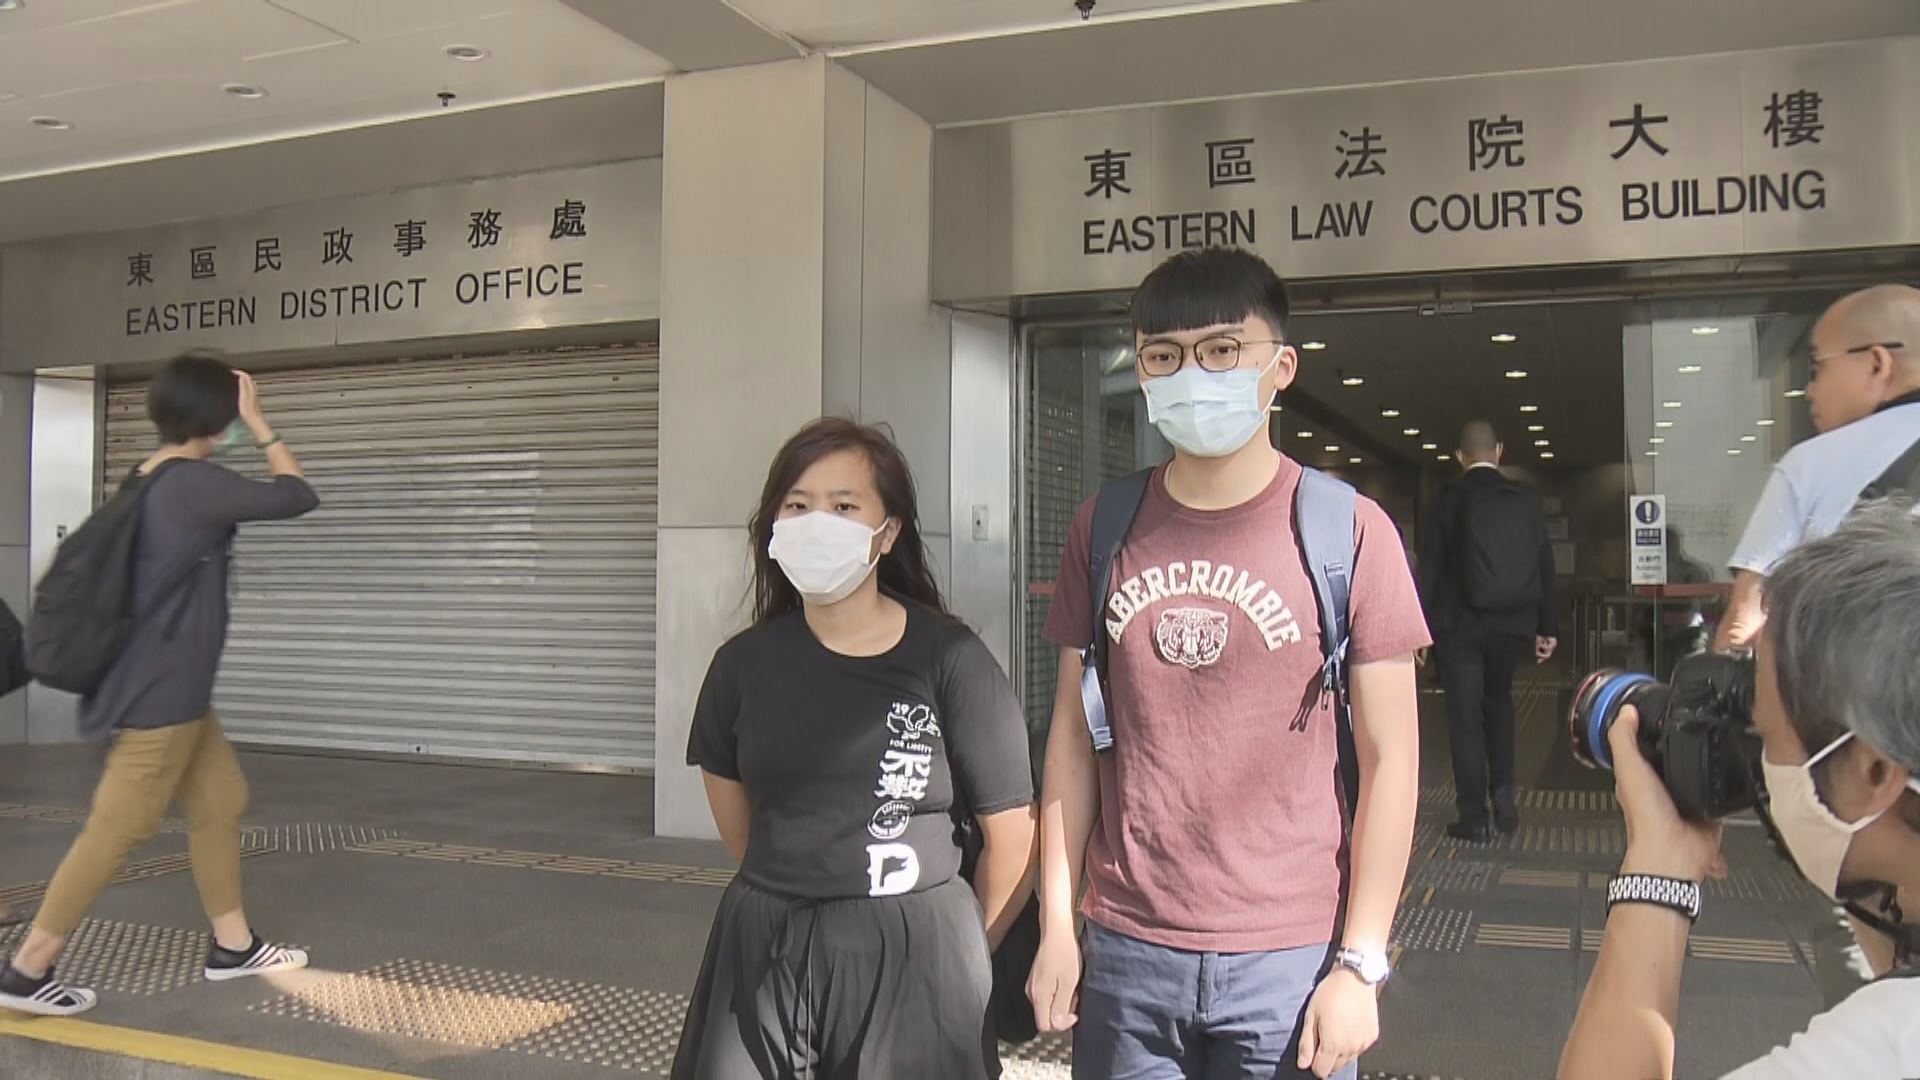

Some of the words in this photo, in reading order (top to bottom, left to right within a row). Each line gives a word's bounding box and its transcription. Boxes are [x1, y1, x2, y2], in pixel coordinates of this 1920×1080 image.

[1083, 89, 1825, 199] 東區法院大樓
[127, 199, 587, 286] 東區民政事務處
[1083, 208, 1255, 255] EASTERN
[1291, 200, 1373, 241] LAW
[1410, 185, 1583, 235] COURTS
[1622, 170, 1826, 221] BUILDING
[126, 297, 257, 335] EASTERN
[280, 277, 427, 320] DISTRICT
[456, 262, 583, 304] OFFICE
[1105, 560, 1302, 652] ABERCROMBIE
